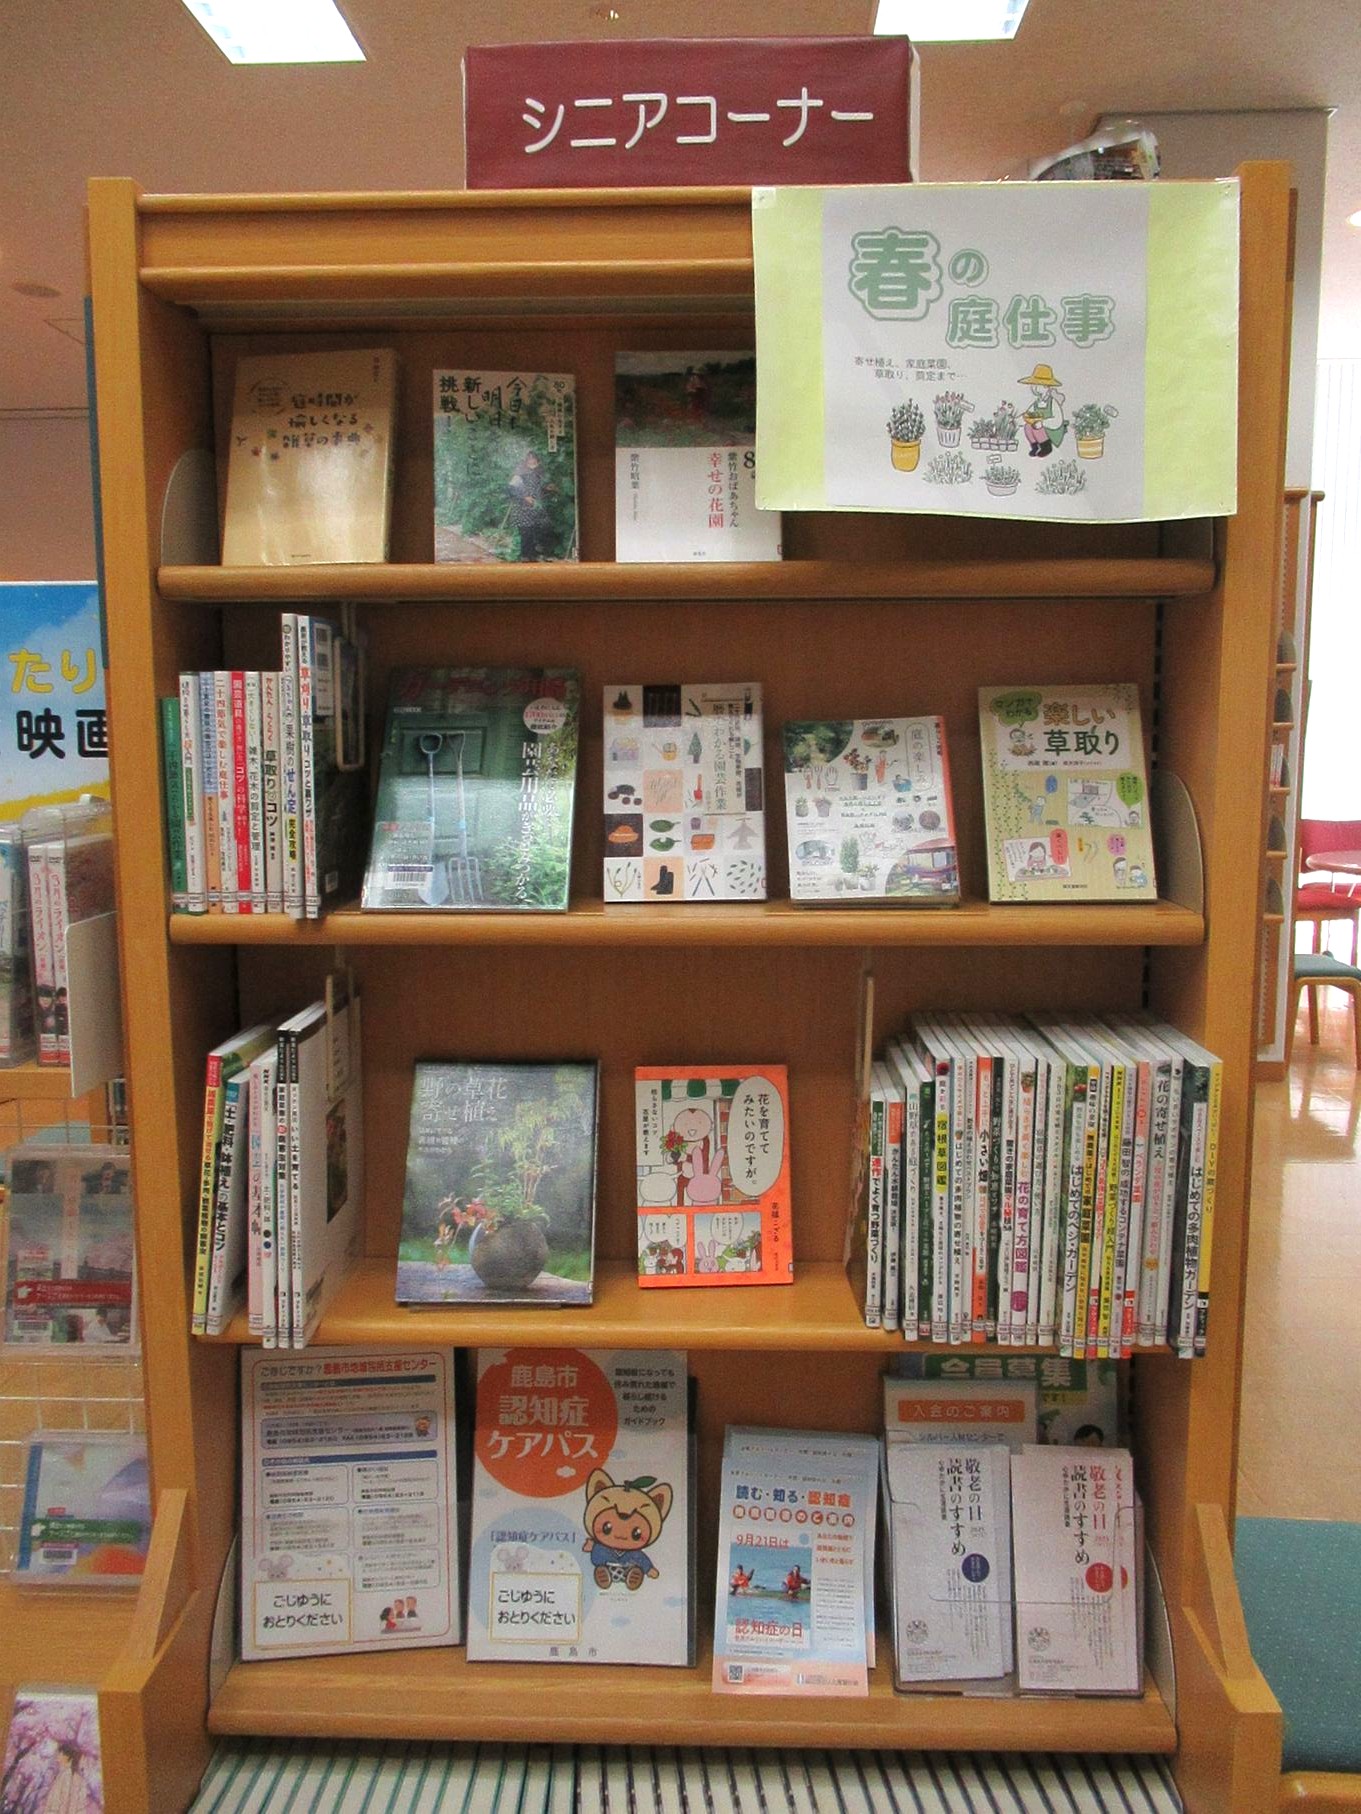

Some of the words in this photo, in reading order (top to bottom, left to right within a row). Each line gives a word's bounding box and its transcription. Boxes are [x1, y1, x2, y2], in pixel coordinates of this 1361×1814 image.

[522, 87, 874, 153] シニアコーナー
[945, 294, 1116, 348] 庭仕事
[707, 452, 724, 529] 幸せの花園
[1043, 702, 1116, 726] 楽しい
[1043, 726, 1119, 756] 草取り
[419, 1077, 507, 1101] 野の草花
[420, 1101, 498, 1123] 寄せ植え
[757, 1093, 771, 1155] 花を育てて
[1154, 1079, 1170, 1159] 花の寄せ植え
[743, 1095, 758, 1185] みたいのですが。
[936, 1119, 948, 1186] 宿根草図鑑
[1014, 1181, 1030, 1273] 花の育て方図鑑
[511, 1364, 578, 1389] 鹿島市
[499, 1396, 589, 1428] 認知症
[624, 1417, 666, 1427] ガイドブック
[633, 1405, 656, 1414] ための
[912, 1403, 1012, 1420] 入会のご案内
[486, 1431, 599, 1460] ケアパス
[964, 1457, 984, 1522] 敬老の日
[1089, 1464, 1108, 1530] 敬老の日
[946, 1458, 967, 1556] 読書のすすめ
[1070, 1464, 1091, 1566] 読書のすすめ
[735, 1532, 790, 1549] 9月21日は
[262, 1612, 343, 1629] おとりください
[498, 1609, 576, 1626] おとりください
[734, 1617, 804, 1639] 認知症の日
